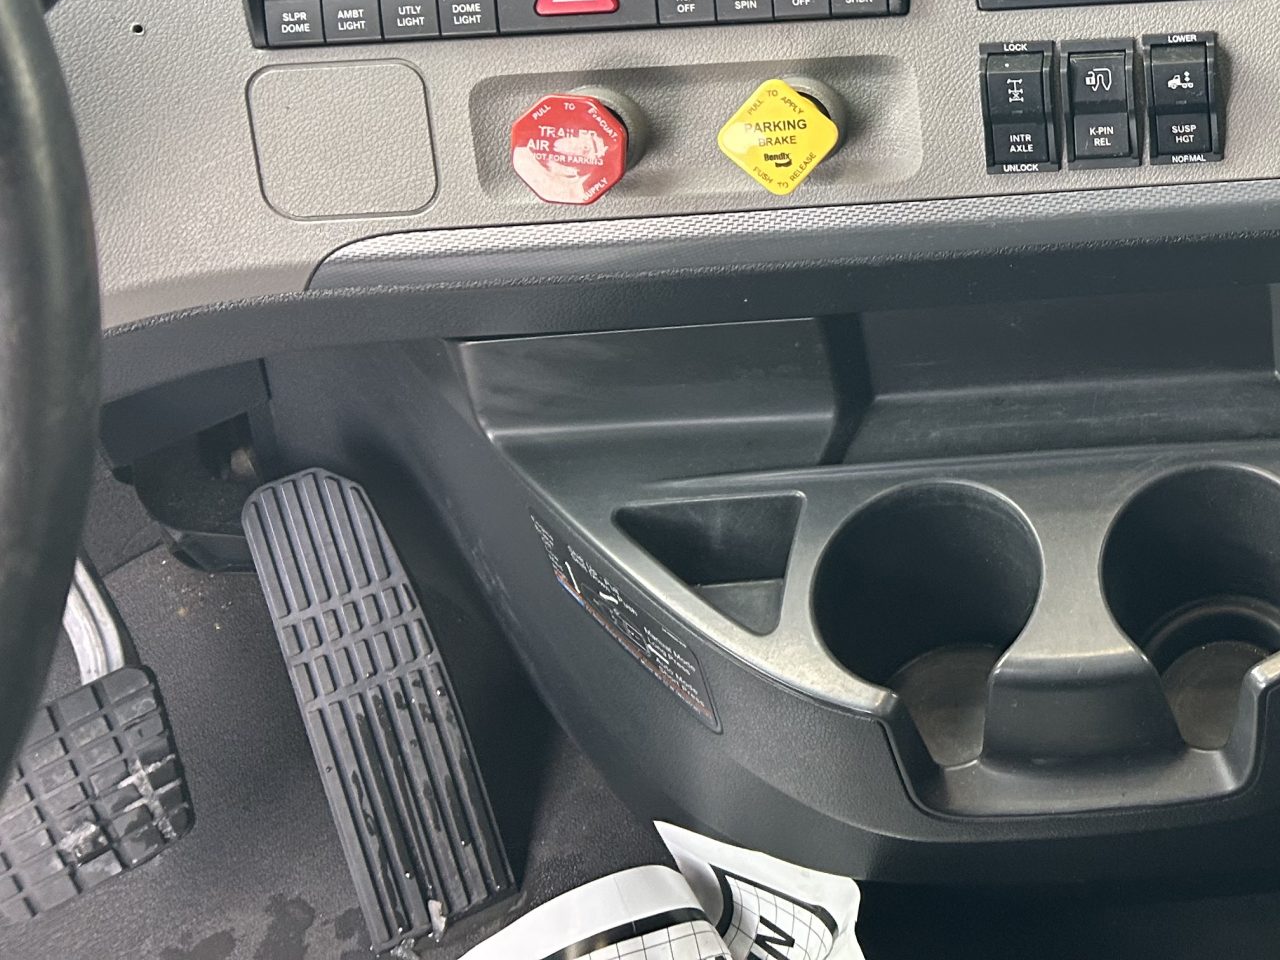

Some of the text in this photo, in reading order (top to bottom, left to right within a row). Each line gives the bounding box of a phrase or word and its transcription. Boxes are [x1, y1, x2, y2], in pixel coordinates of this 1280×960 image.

[398, 4, 422, 16] UTLY
[452, 2, 481, 13] DOME
[676, 2, 696, 13] OFF
[734, 0, 757, 10] SPIN
[282, 11, 307, 22] SLPR
[337, 8, 364, 19] AMBT
[397, 16, 425, 27] LIGHT
[454, 14, 482, 25] LIGHT
[281, 23, 310, 33] DOME
[338, 20, 366, 31] LIGHT
[1167, 34, 1197, 43] LOWER
[1003, 43, 1028, 52] LOCK
[747, 89, 805, 115] PULL TO APPLY
[532, 103, 551, 120] PULL
[563, 102, 576, 111] TO
[744, 119, 808, 133] PARKING
[1089, 126, 1114, 136] K-PIN
[1171, 125, 1197, 134] SUSP
[758, 135, 797, 147] BRAKE
[1009, 134, 1032, 143] INTR
[1094, 138, 1111, 146] REL
[1175, 134, 1195, 143] HGT
[527, 138, 550, 152] AIR
[1009, 144, 1034, 153] AXLE
[548, 153, 566, 163] FOR
[763, 152, 790, 162] Bendix
[753, 152, 817, 189] PUSH TO RELEASE
[1003, 164, 1039, 173] UNLOCK
